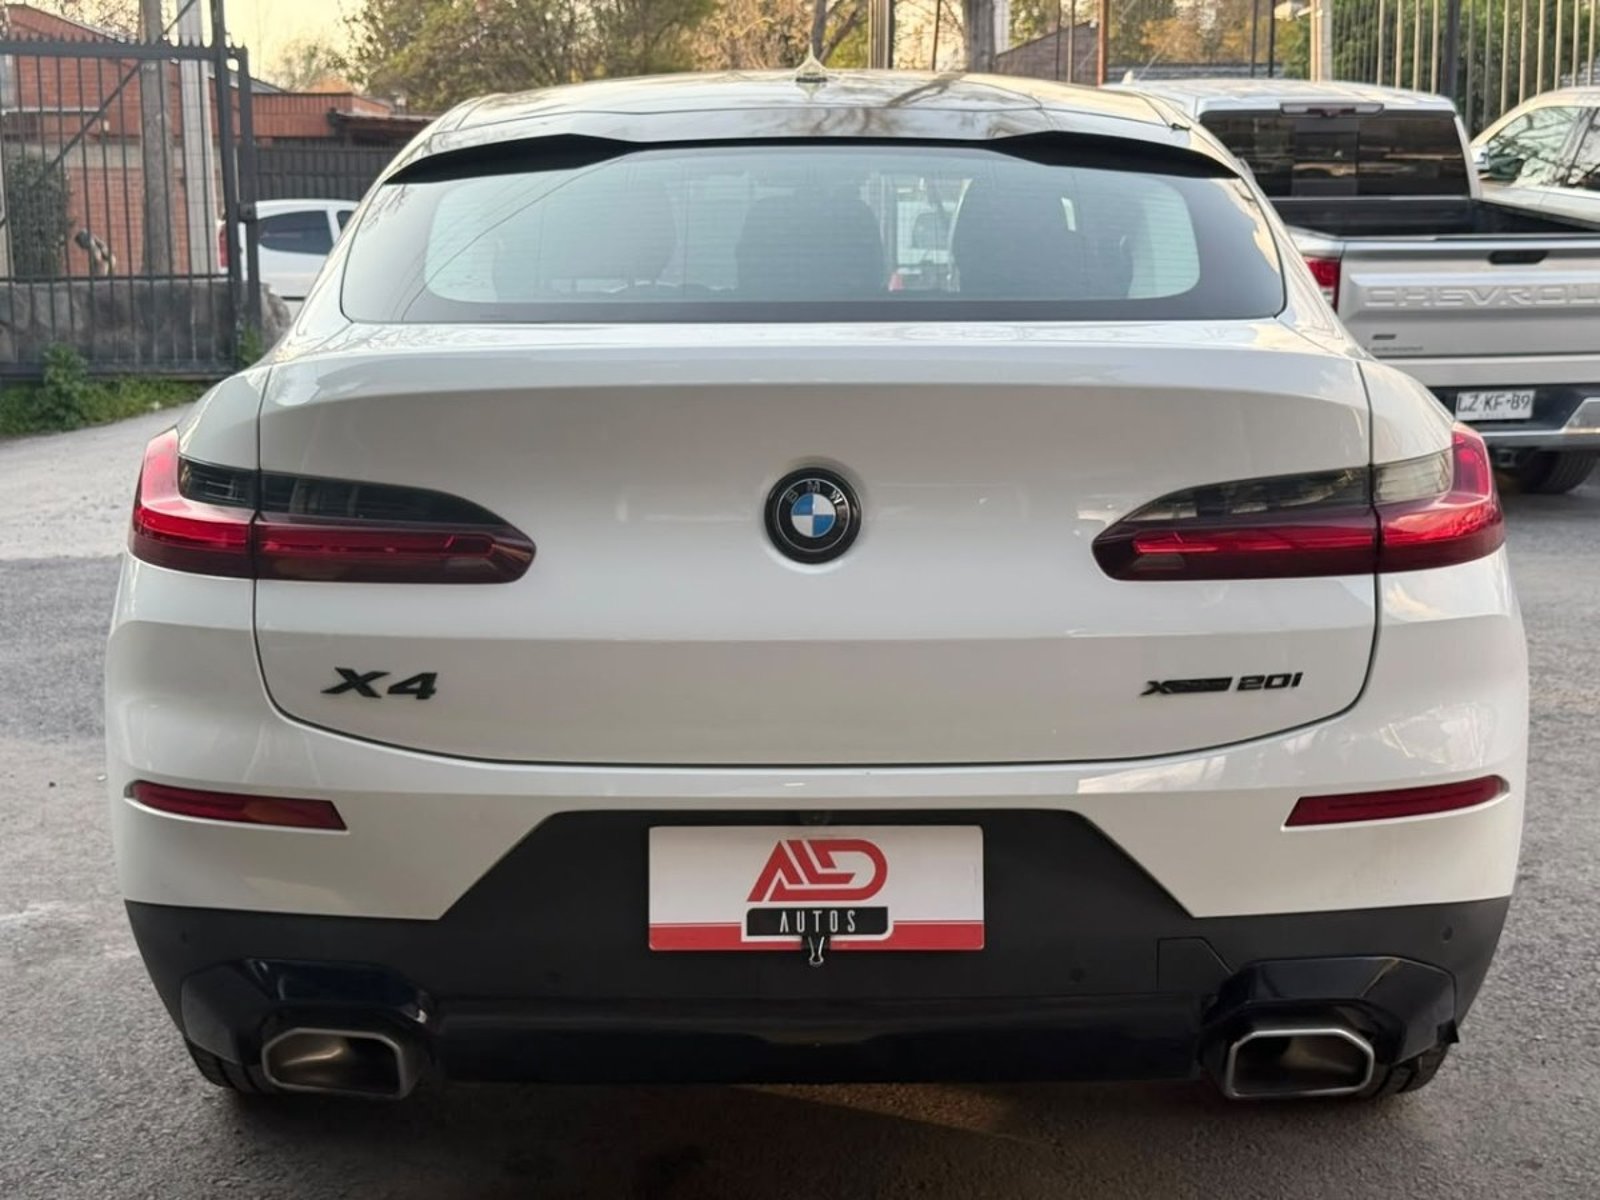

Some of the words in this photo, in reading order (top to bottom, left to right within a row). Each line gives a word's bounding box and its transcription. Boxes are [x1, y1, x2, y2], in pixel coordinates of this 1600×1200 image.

[1365, 286, 1600, 307] CHEVROL
[785, 481, 843, 504] BMW
[320, 667, 438, 700] X4
[780, 910, 856, 933] AUTOS
